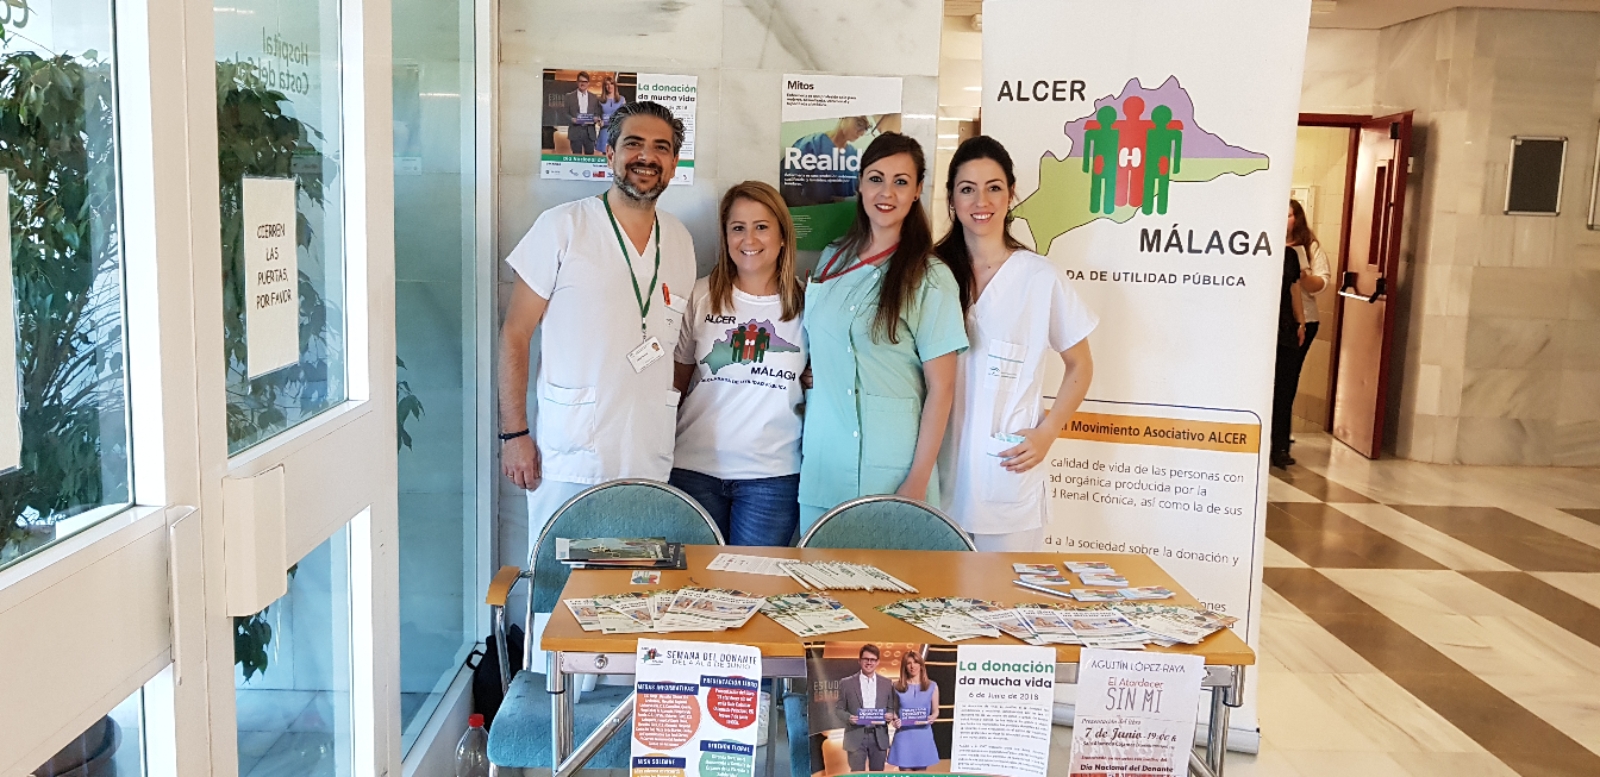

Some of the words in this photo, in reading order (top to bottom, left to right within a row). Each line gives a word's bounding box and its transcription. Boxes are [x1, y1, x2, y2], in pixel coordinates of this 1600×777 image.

[638, 83, 650, 91] La
[652, 83, 696, 93] donación
[787, 80, 814, 90] Mitos
[997, 80, 1086, 102] ALCER
[784, 147, 863, 171] Realid
[1139, 223, 1272, 256] MÁLAGA
[266, 246, 279, 261] LAS
[1089, 270, 1108, 282] DE
[1112, 271, 1177, 284] UTILIDAD
[1182, 272, 1246, 287] PÚBLICA
[704, 314, 736, 324] ALCER
[751, 366, 796, 381] MÁLAGA
[1071, 420, 1140, 436] Movimiento
[1143, 425, 1205, 442] Asociativo
[1208, 431, 1247, 445] ALCER
[1051, 458, 1089, 470] calidad
[1092, 460, 1106, 471] de
[1109, 462, 1131, 473] vida
[1134, 463, 1148, 475] de
[1151, 465, 1166, 476] las
[1169, 469, 1220, 481] personas
[1223, 473, 1244, 483] con
[1065, 475, 1111, 488] orgánica
[1115, 479, 1171, 492] producida
[1174, 485, 1194, 496] por
[1197, 485, 1207, 496] la
[1060, 489, 1089, 501] Renal
[1092, 491, 1137, 507] Crónica,
[1140, 497, 1156, 507] así
[1158, 500, 1190, 511] como
[1193, 501, 1203, 513] la
[1206, 503, 1221, 515] de
[1224, 506, 1243, 516] sus
[1055, 537, 1062, 545] a
[1066, 536, 1075, 546] la
[1078, 539, 1126, 552] sociedad
[1129, 544, 1160, 556] sobre
[1163, 546, 1173, 558] la
[1176, 548, 1229, 563] donación
[1232, 556, 1239, 567] y
[666, 650, 700, 660] SEMANA
[702, 652, 717, 661] DEL
[719, 653, 757, 666] DONANTE
[1091, 660, 1128, 670] AGUSTÍN
[959, 661, 977, 671] La
[981, 660, 1054, 673] donación
[959, 676, 975, 685] da
[979, 677, 1020, 687] mucha
[1025, 677, 1052, 688] vida
[1107, 676, 1117, 686] El
[1119, 678, 1164, 689] Atardecer
[1020, 693, 1039, 701] 2018
[1105, 687, 1136, 711] SIN
[1085, 727, 1092, 738] 7
[1095, 728, 1108, 739] de
[1111, 728, 1142, 740] Junio
